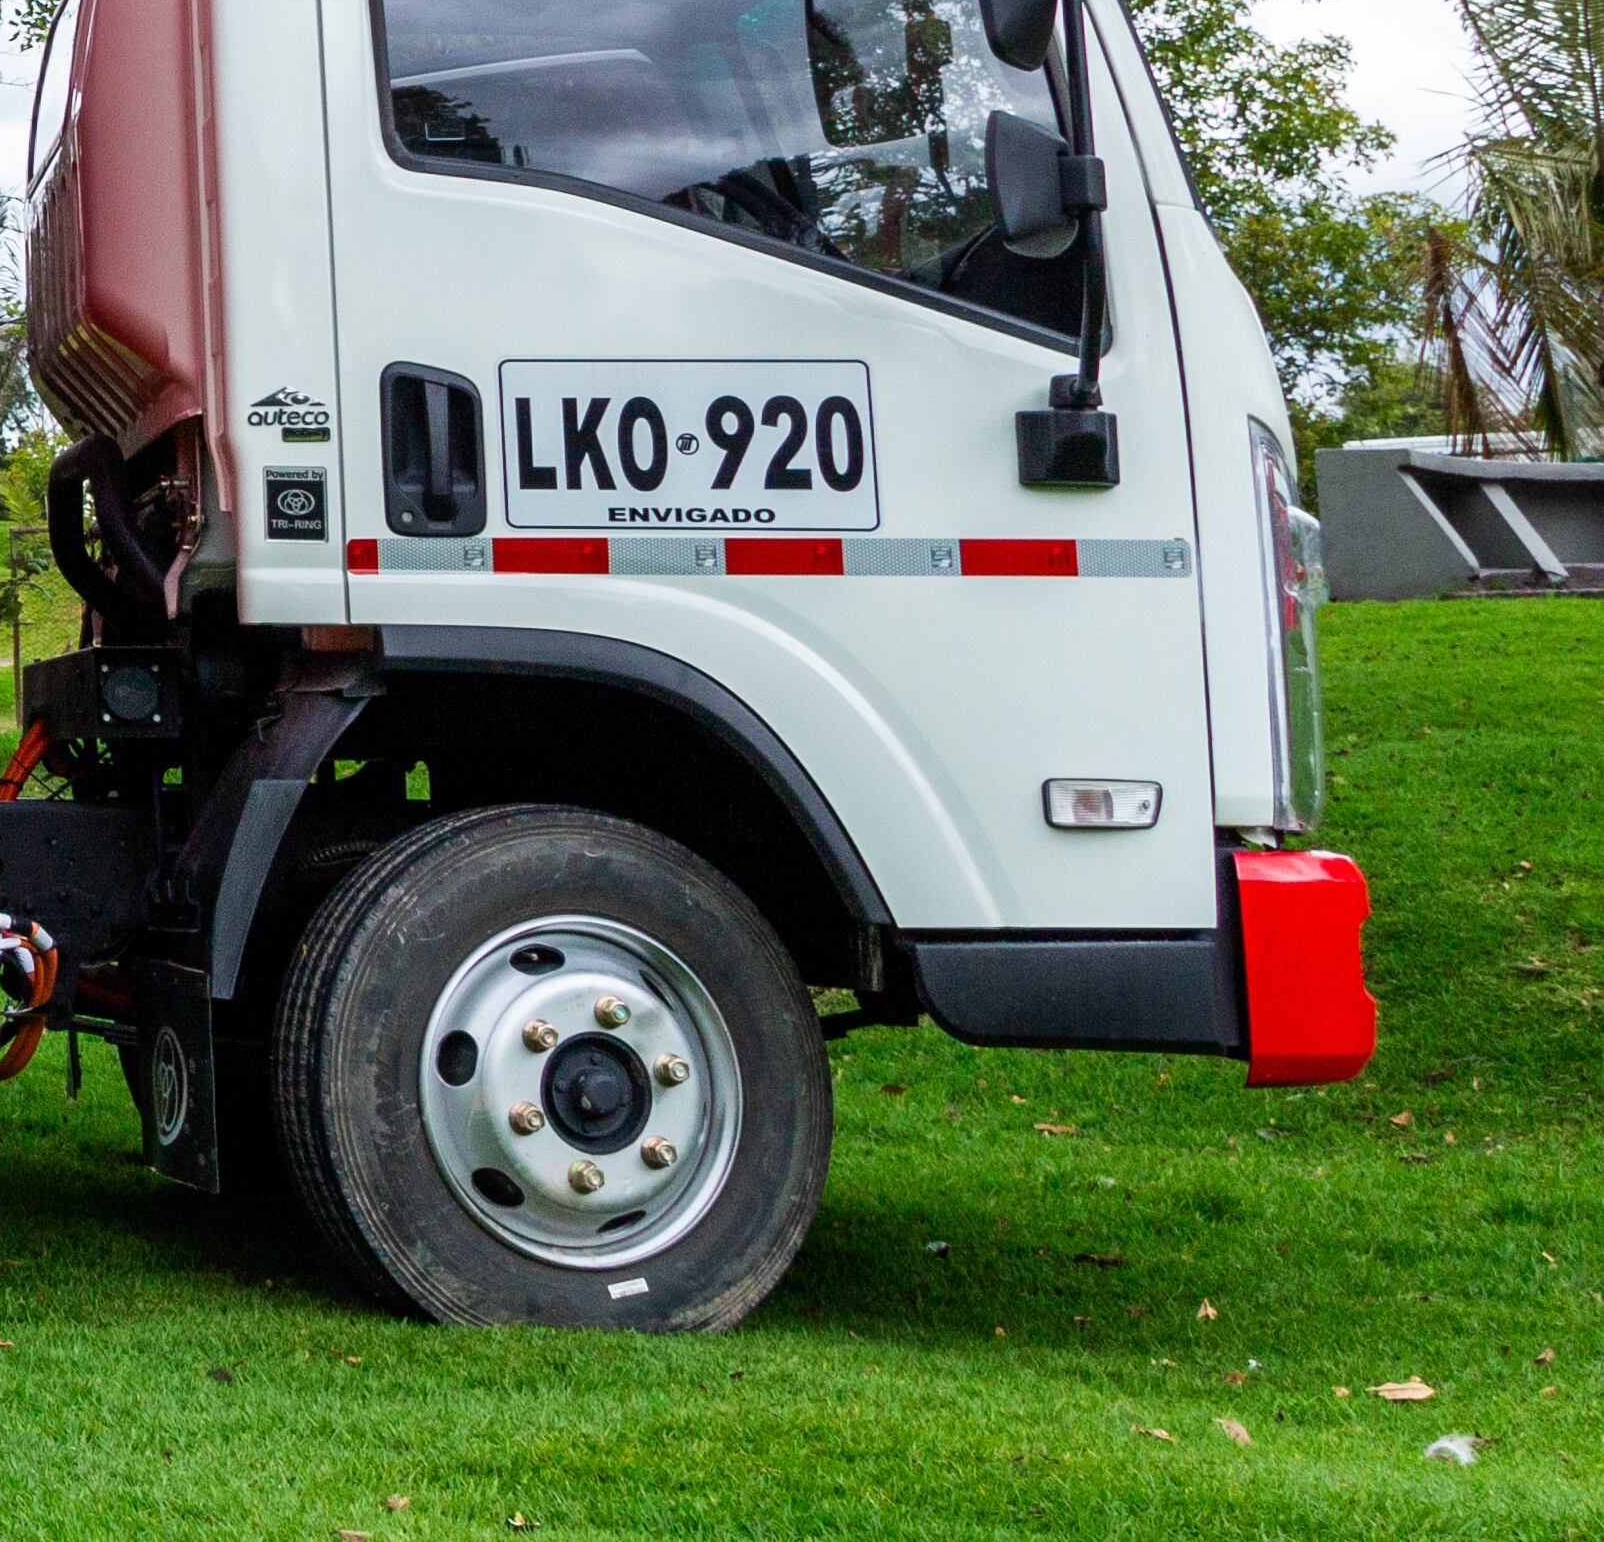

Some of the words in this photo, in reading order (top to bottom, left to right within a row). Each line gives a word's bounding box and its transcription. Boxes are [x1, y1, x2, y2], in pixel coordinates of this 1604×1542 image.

[247, 408, 330, 427] auteco
[265, 469, 309, 479] Powered
[311, 469, 324, 480] by
[607, 507, 777, 525] ENVIGADO
[270, 519, 323, 530] TRI-RING
